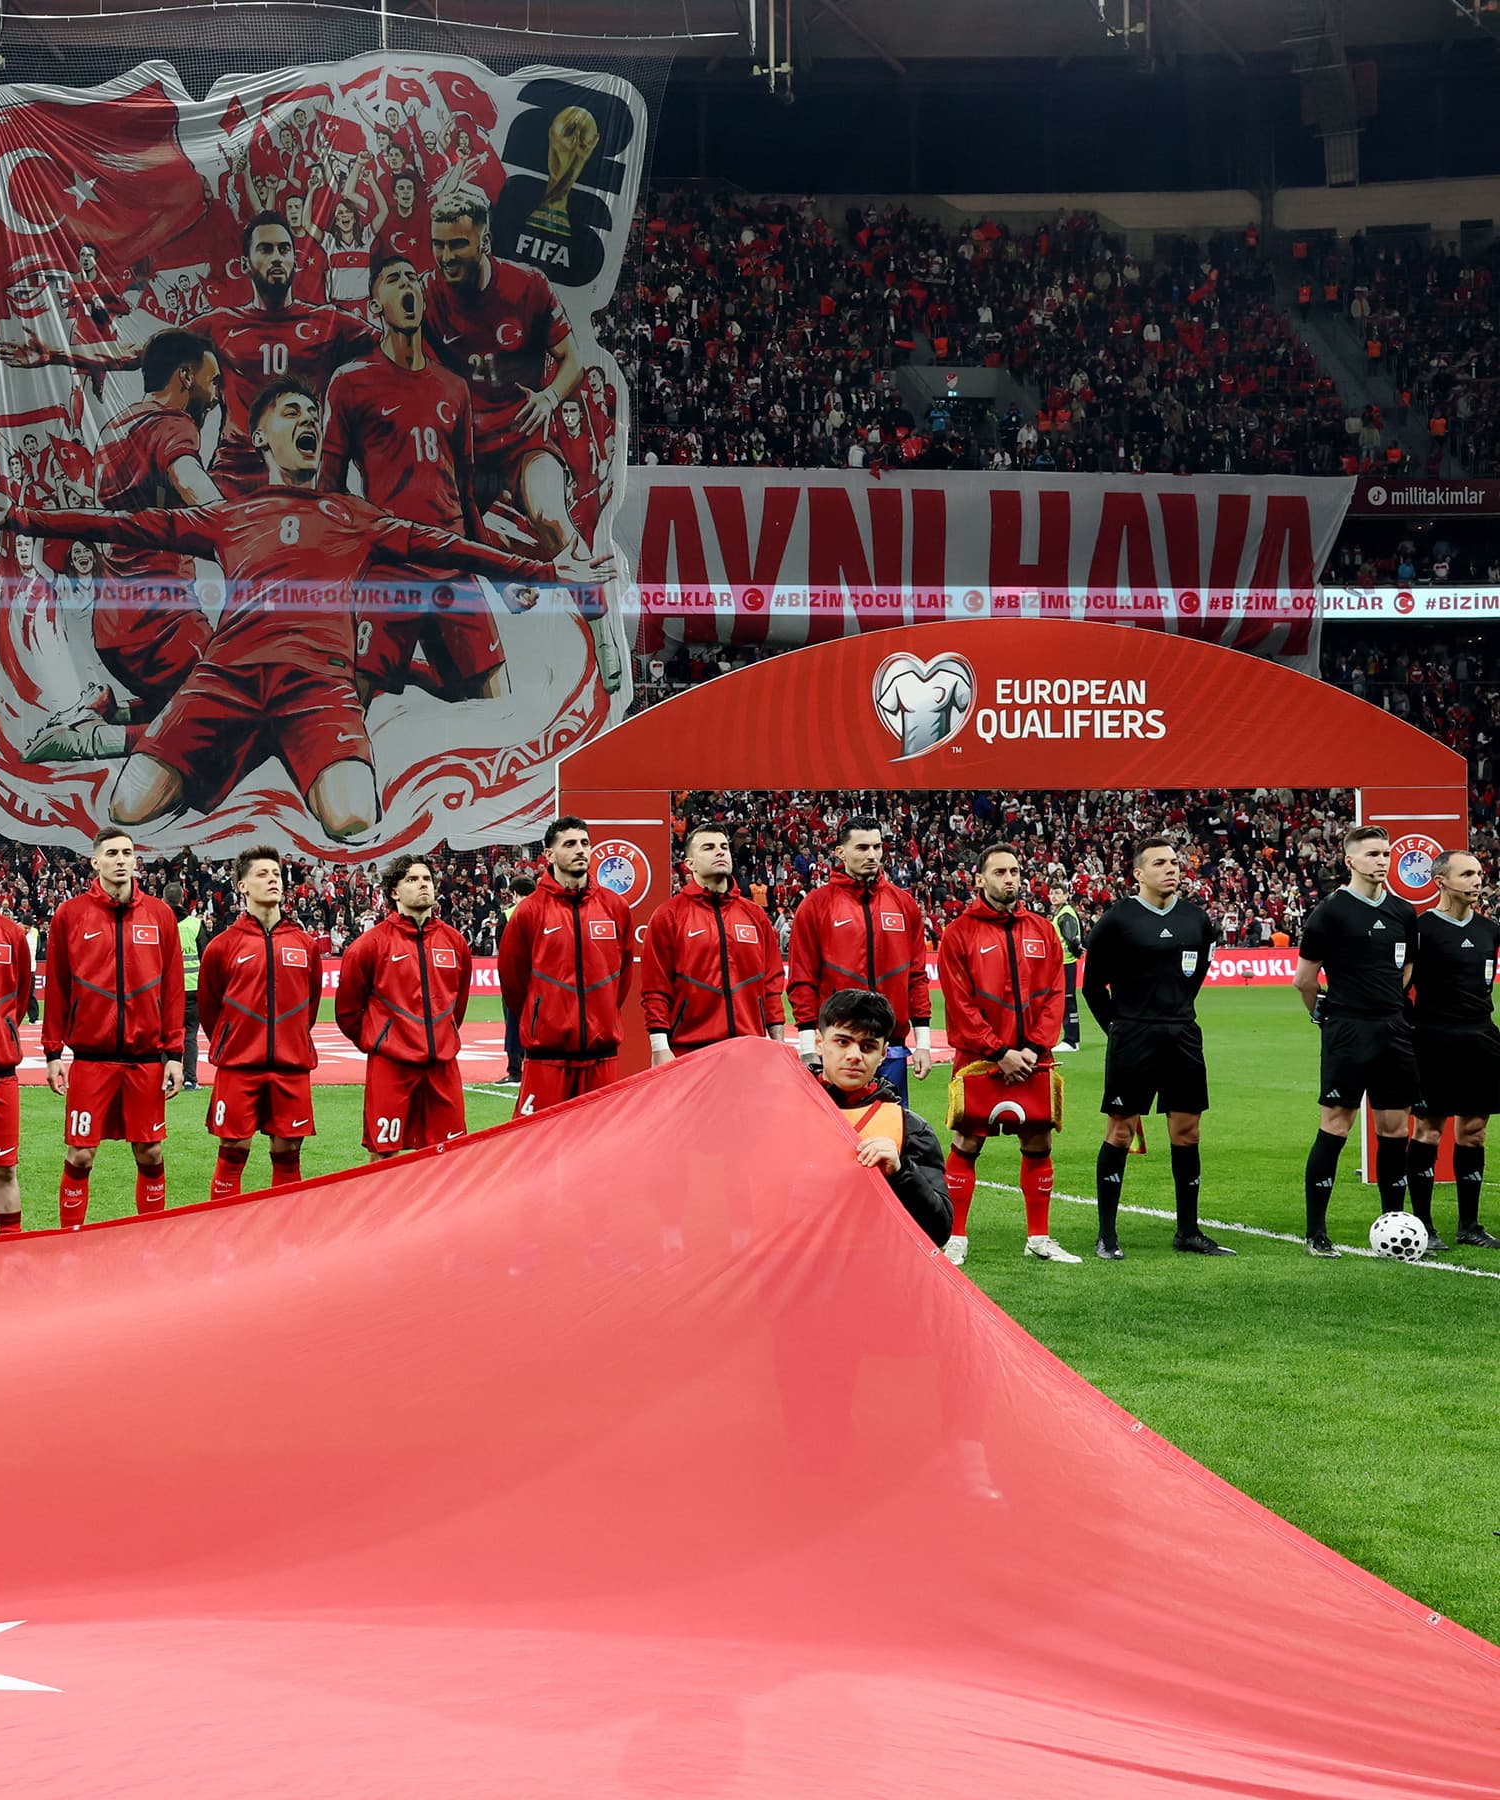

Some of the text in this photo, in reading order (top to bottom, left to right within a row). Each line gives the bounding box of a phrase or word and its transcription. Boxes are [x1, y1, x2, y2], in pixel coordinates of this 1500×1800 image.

[515, 233, 571, 268] FIFA
[259, 343, 289, 376] 10
[410, 426, 439, 463] 18
[1391, 485, 1486, 506] millitakimlar
[279, 515, 301, 545] 8
[636, 486, 947, 655] AYNI
[988, 489, 1316, 656] HAVA
[356, 620, 374, 657] 8
[996, 678, 1146, 705] EUROPEAN
[976, 708, 1166, 744] QUALIFIERS
[595, 844, 636, 861] UEFA
[1396, 838, 1435, 855] UEFA
[70, 1109, 92, 1137] 18
[215, 1099, 227, 1127] 8
[376, 1116, 401, 1144] 20
